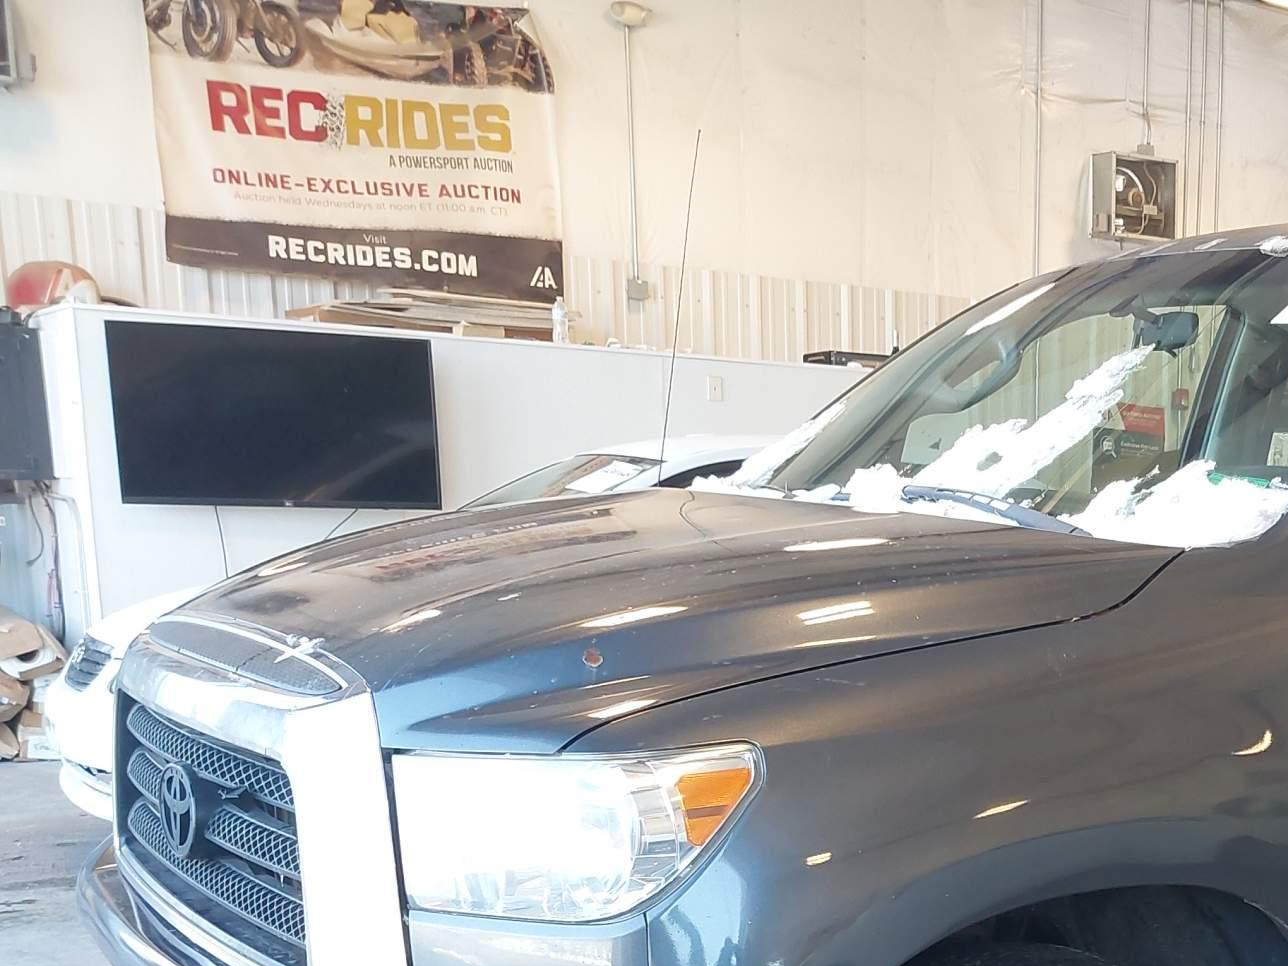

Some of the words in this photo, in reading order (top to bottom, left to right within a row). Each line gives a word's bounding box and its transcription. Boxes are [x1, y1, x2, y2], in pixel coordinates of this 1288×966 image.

[206, 80, 328, 142] REC
[344, 95, 513, 153] RIDES
[389, 155, 397, 168] A
[400, 155, 469, 170] POWERSPORT
[473, 158, 514, 174] AUCTION
[212, 168, 430, 197] ONLINE-EXCLUSIVE
[438, 184, 522, 204] AUCTION
[234, 192, 274, 203] Auction
[304, 198, 374, 211] Wednesdays
[363, 233, 387, 245] Visit
[267, 235, 478, 278] RECRIDES.COM
